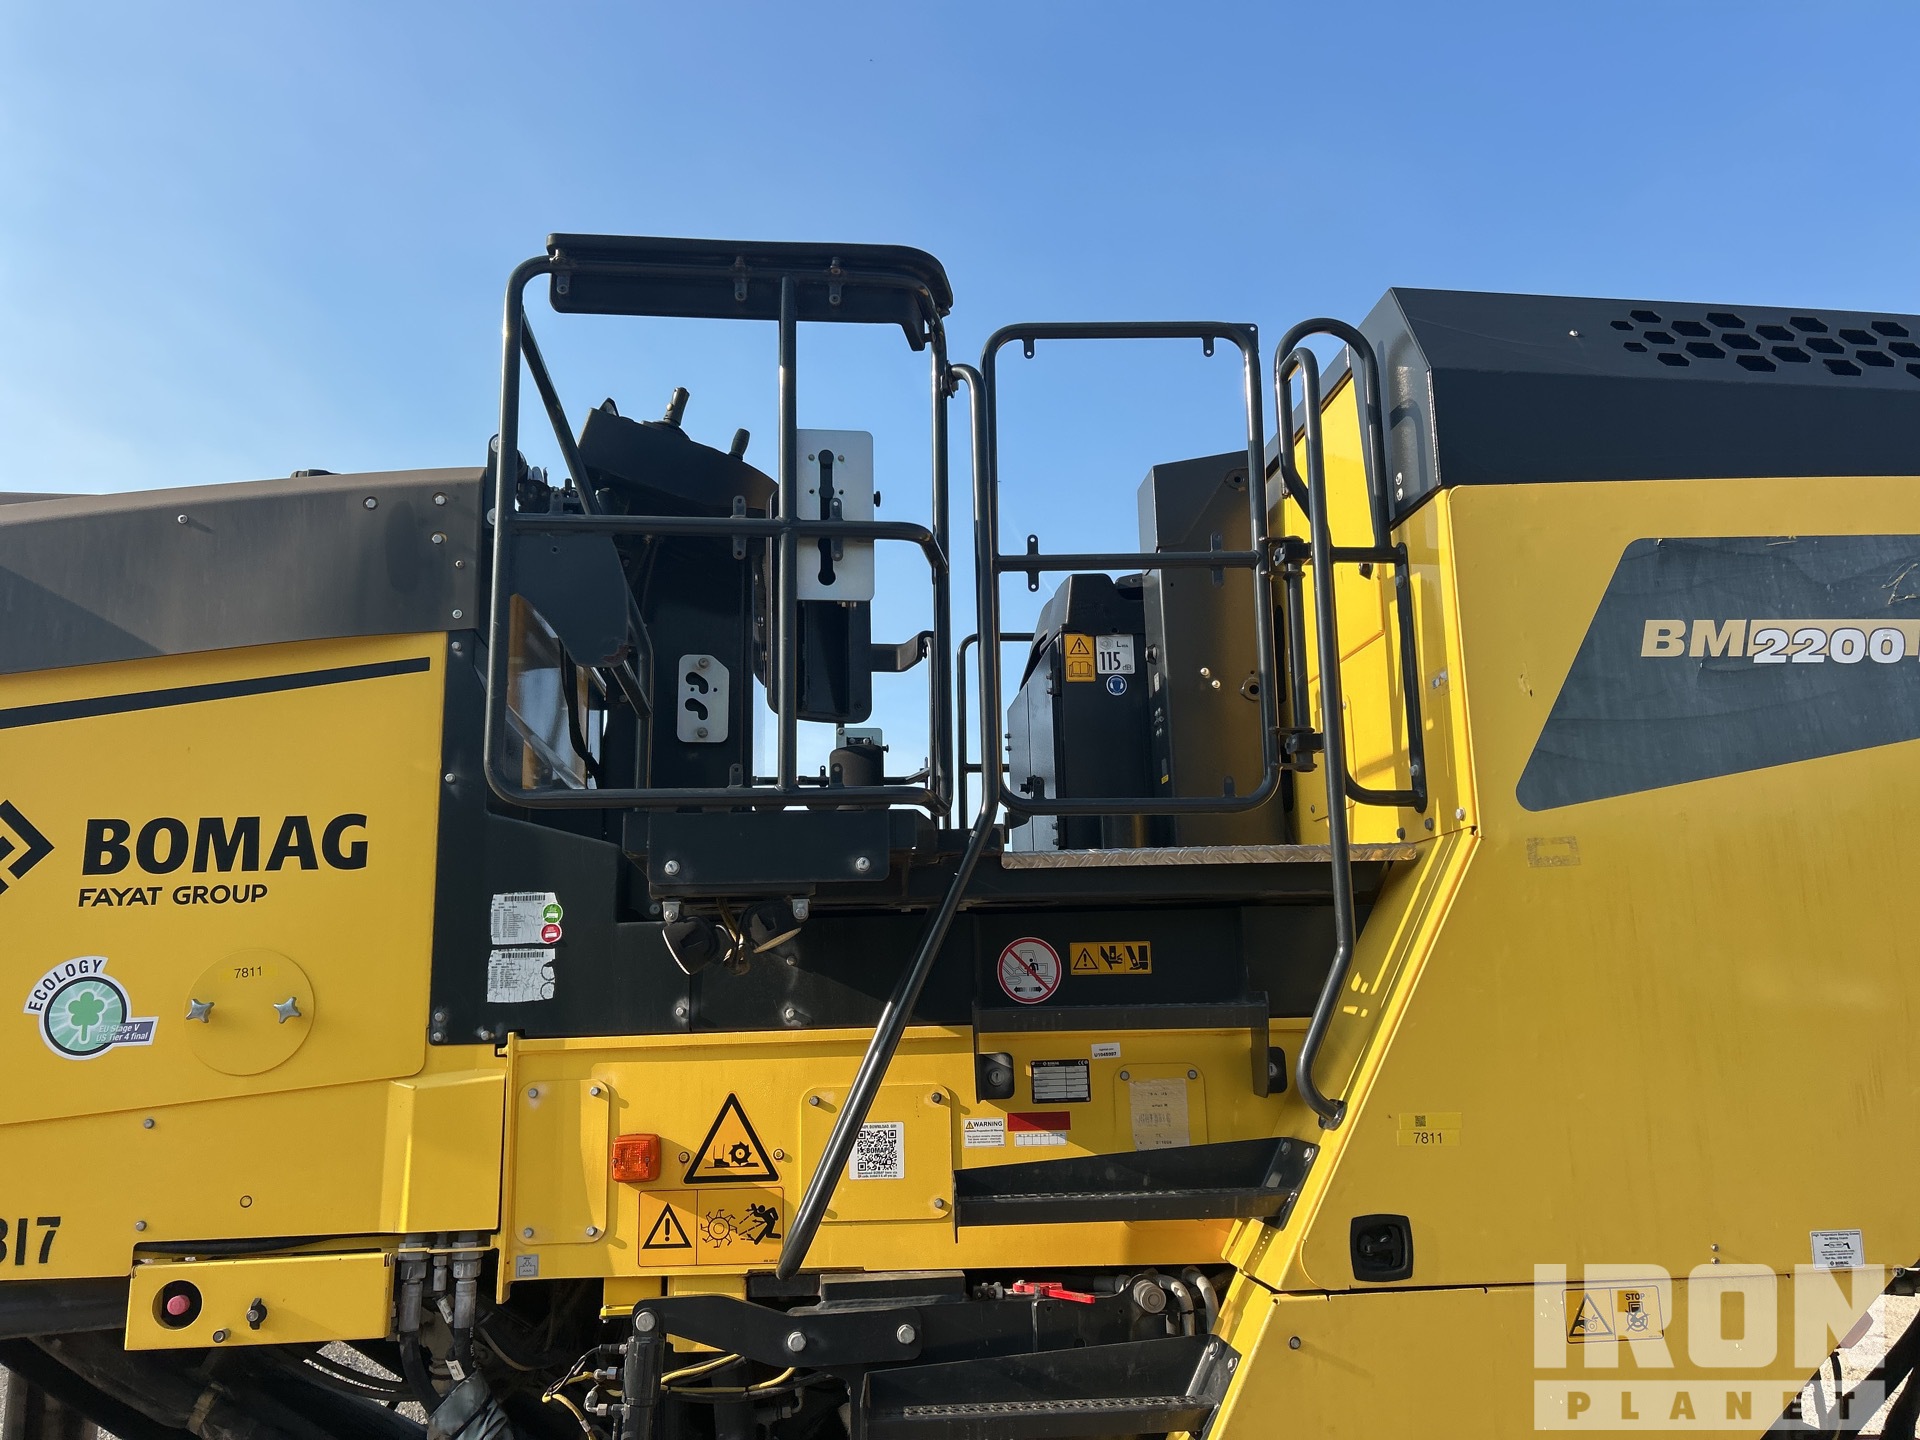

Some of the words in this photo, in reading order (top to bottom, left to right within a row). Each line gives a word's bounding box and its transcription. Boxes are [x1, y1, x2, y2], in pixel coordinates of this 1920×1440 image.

[1100, 652, 1121, 670] 115
[82, 813, 368, 875] BOMAG
[78, 887, 163, 907] FAYAT
[172, 884, 268, 905] GROUP
[234, 966, 262, 979] 7811
[28, 959, 103, 1012] ECOLOGY
[111, 1024, 132, 1033] Stage
[134, 1023, 141, 1032] V
[110, 1033, 124, 1041] Tier
[130, 1032, 149, 1040] final
[1413, 1132, 1442, 1144] 7811
